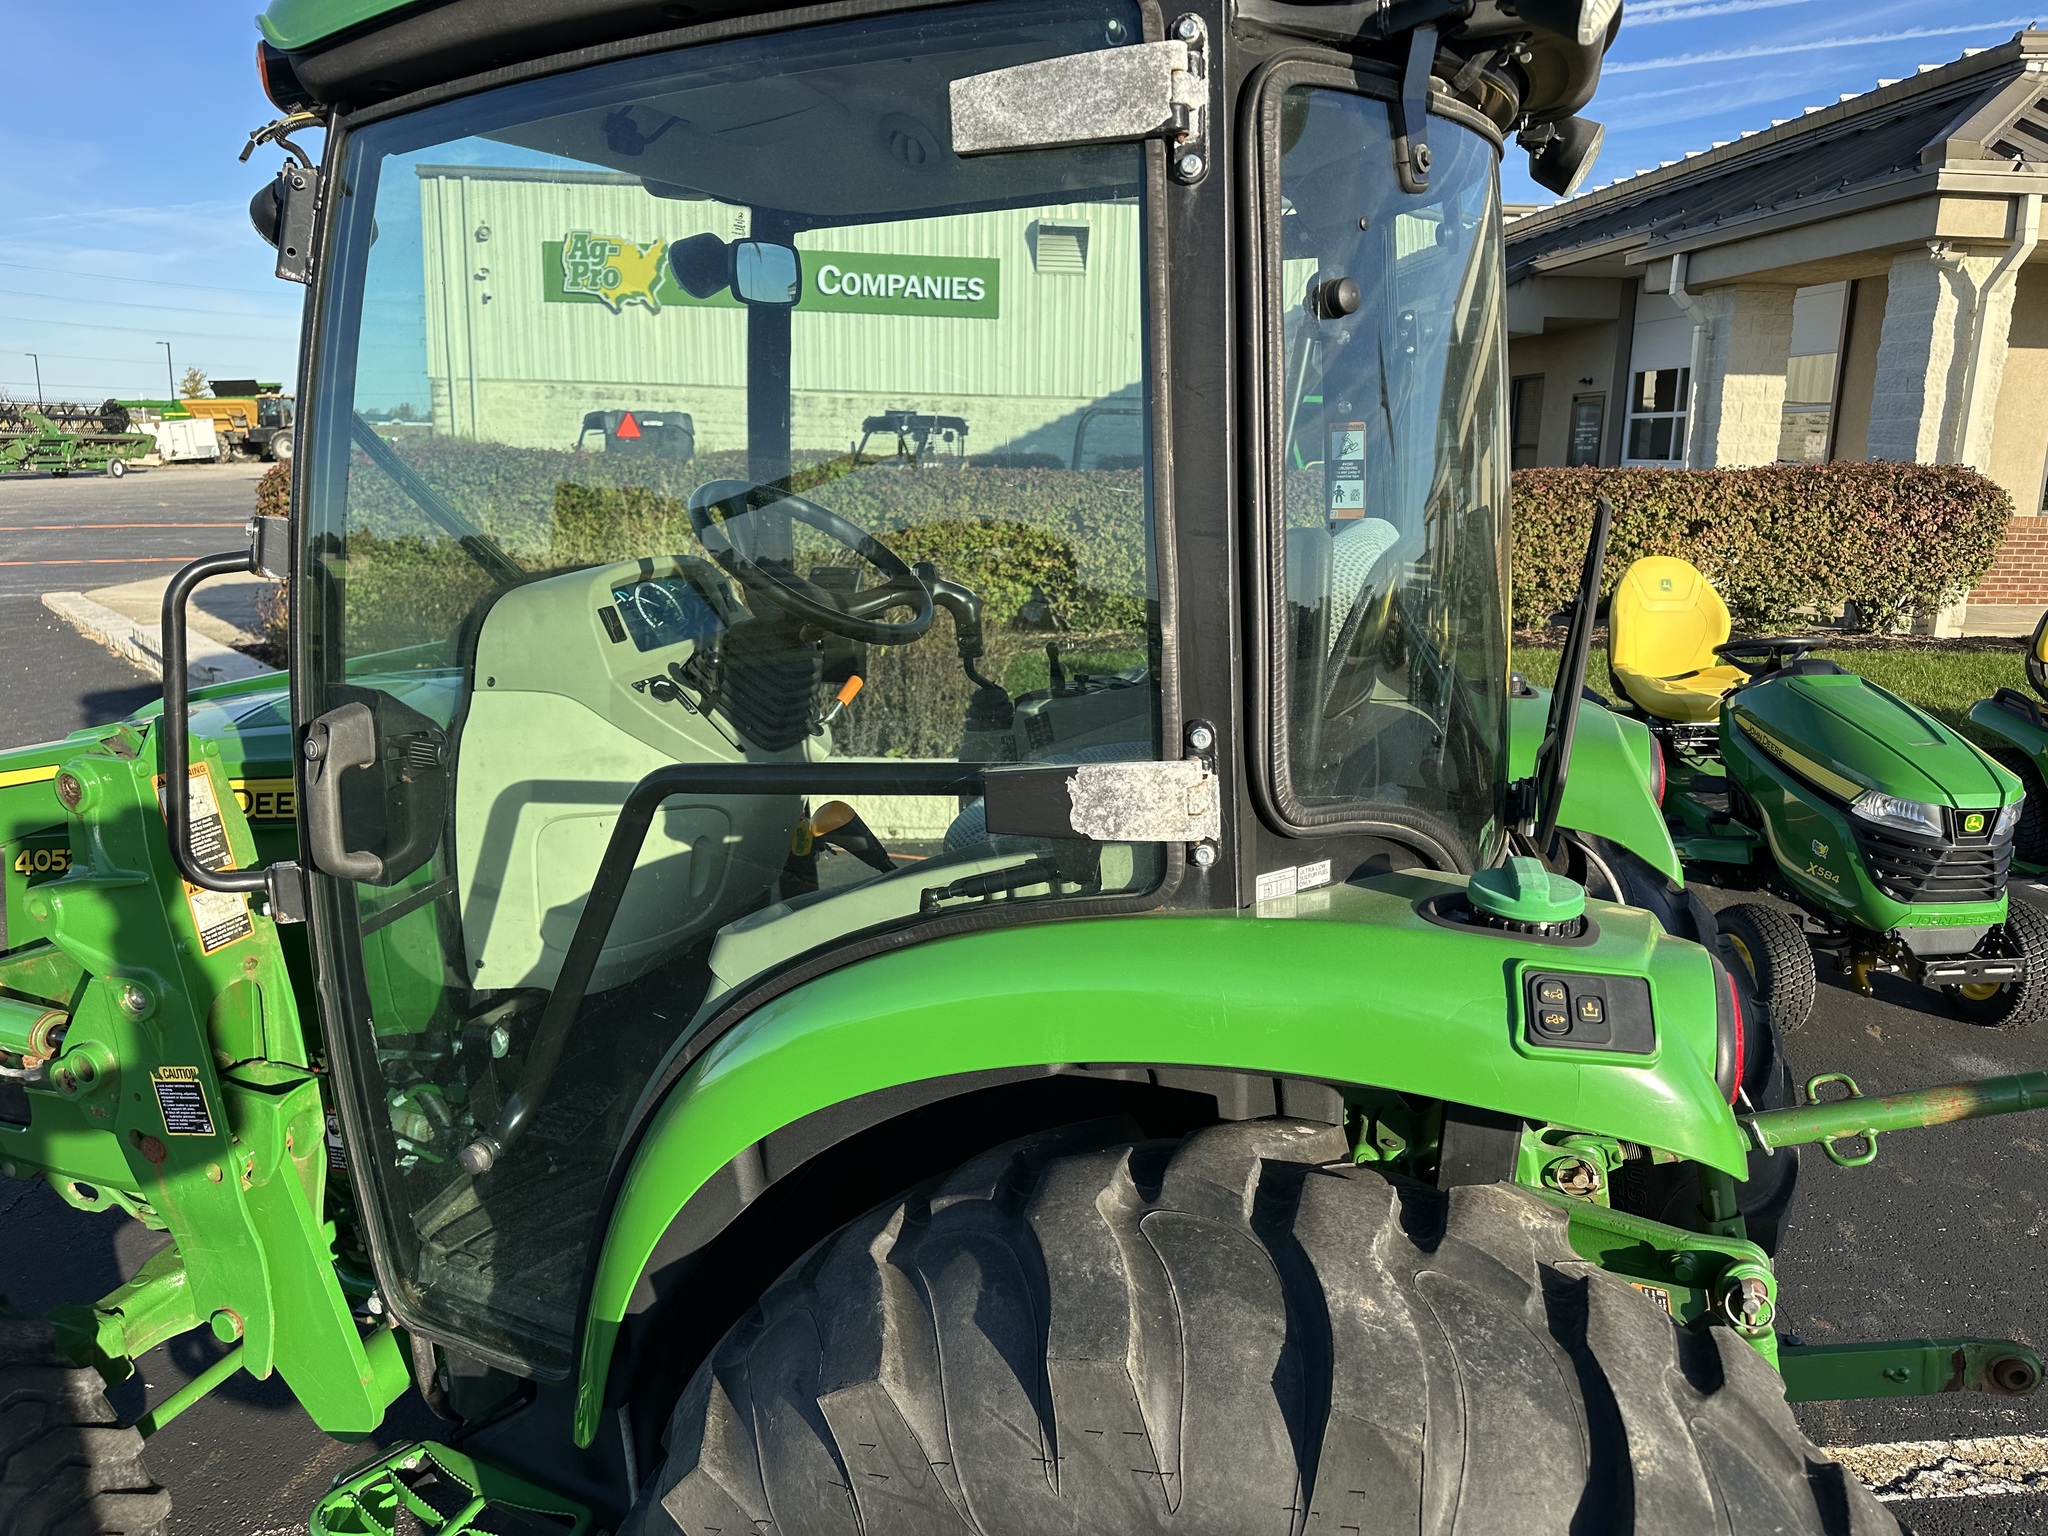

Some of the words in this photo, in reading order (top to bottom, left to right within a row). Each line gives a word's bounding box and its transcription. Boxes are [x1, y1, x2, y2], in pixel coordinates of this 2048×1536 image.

[567, 233, 619, 266] Ag-
[568, 262, 620, 288] Pro
[817, 264, 986, 301] COMPANIES
[1747, 724, 1763, 744] JOHN
[1763, 735, 1784, 758] DEERE
[1806, 861, 1840, 884] X584
[1916, 915, 1951, 926] JOHN
[1955, 913, 1999, 925] DEERE
[163, 1068, 196, 1079] CAUTION
